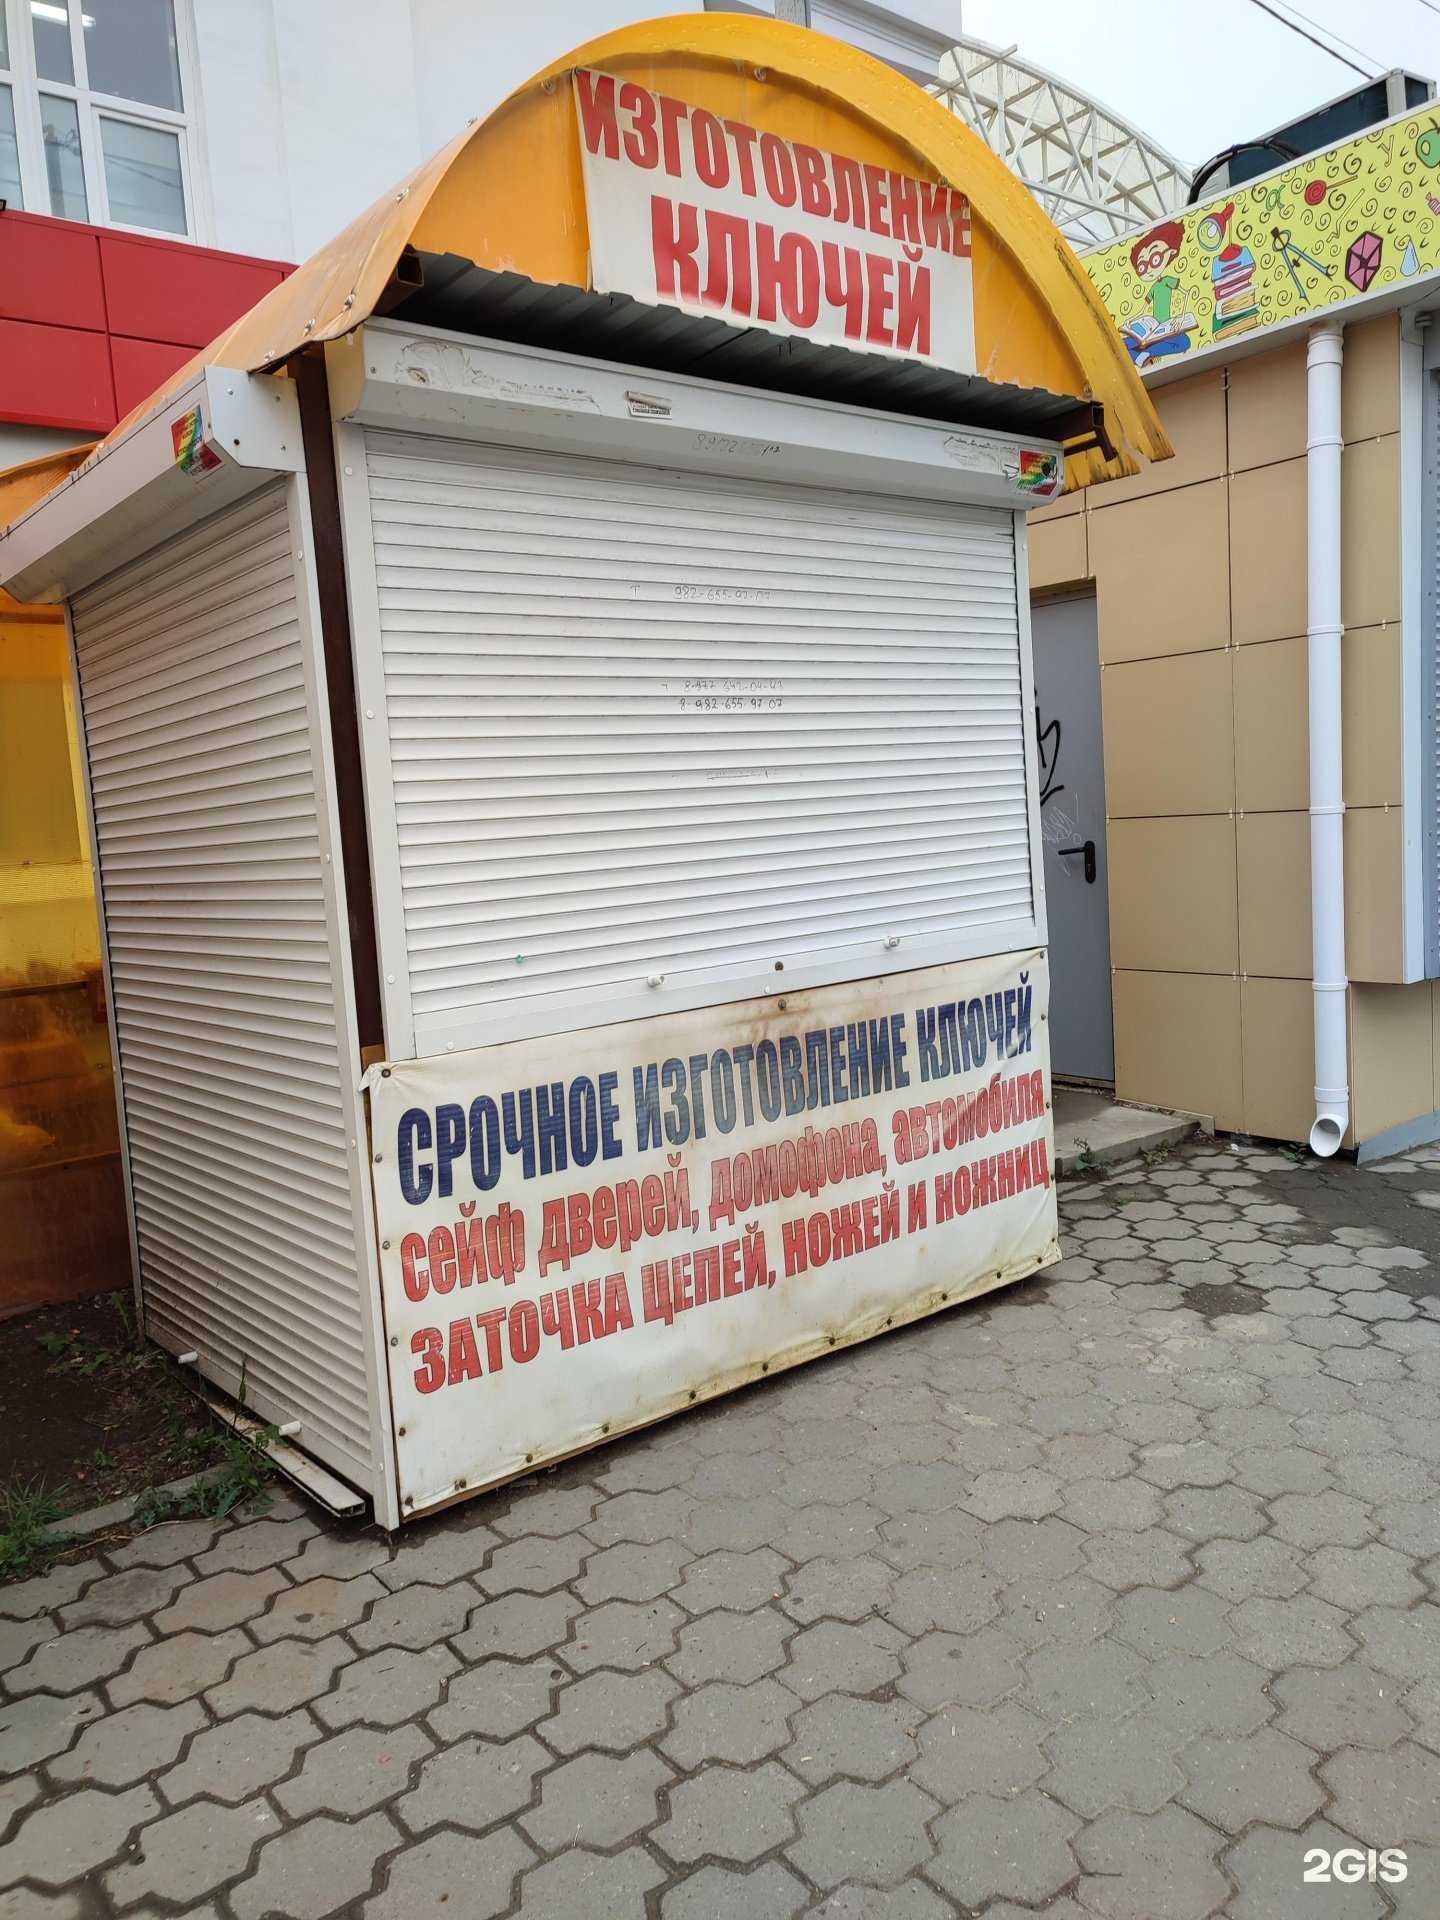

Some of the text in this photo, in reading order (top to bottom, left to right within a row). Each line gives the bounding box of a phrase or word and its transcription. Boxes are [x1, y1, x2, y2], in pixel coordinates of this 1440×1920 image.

[577, 70, 972, 258] ИЗГОТОВЛЕНИЕ
[650, 194, 931, 356] КЛЮЧЕЙ
[397, 972, 1033, 1205] СРОЧНОЕ ИЗГОТОВЛЕНИЕ КЛЮЧЕЙ
[400, 1068, 1045, 1302] сейф дверей, домофона, автомобиля
[410, 1136, 1050, 1395] ЗАТОЧКА ЦЕПЕЙ, НОЖЕЙ И НОЖНИЦ
